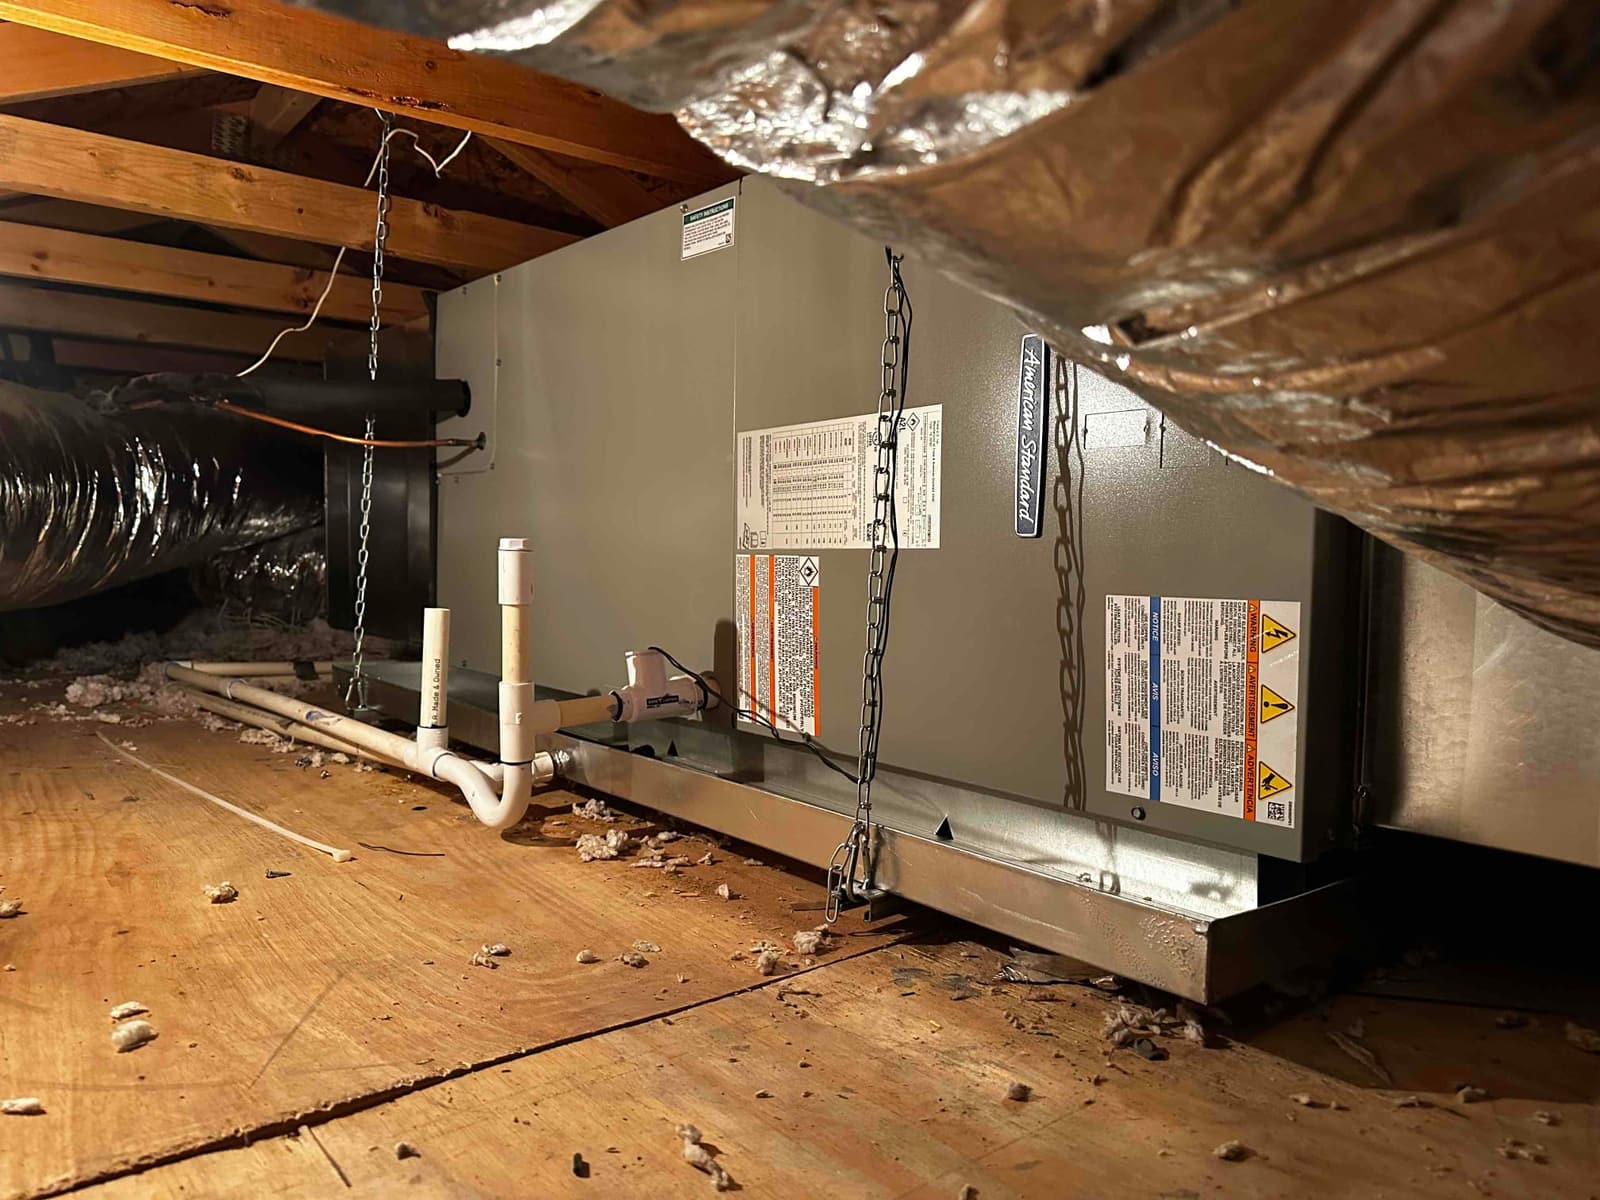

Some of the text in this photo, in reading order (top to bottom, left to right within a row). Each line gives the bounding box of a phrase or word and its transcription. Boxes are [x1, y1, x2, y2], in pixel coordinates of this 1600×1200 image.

[1019, 348, 1041, 524] American Standard
[432, 658, 441, 683] Owned
[432, 692, 440, 712] Made
[1248, 674, 1256, 738] AVERTISSEMENT
[1247, 754, 1255, 814] ADVERTENCIA
